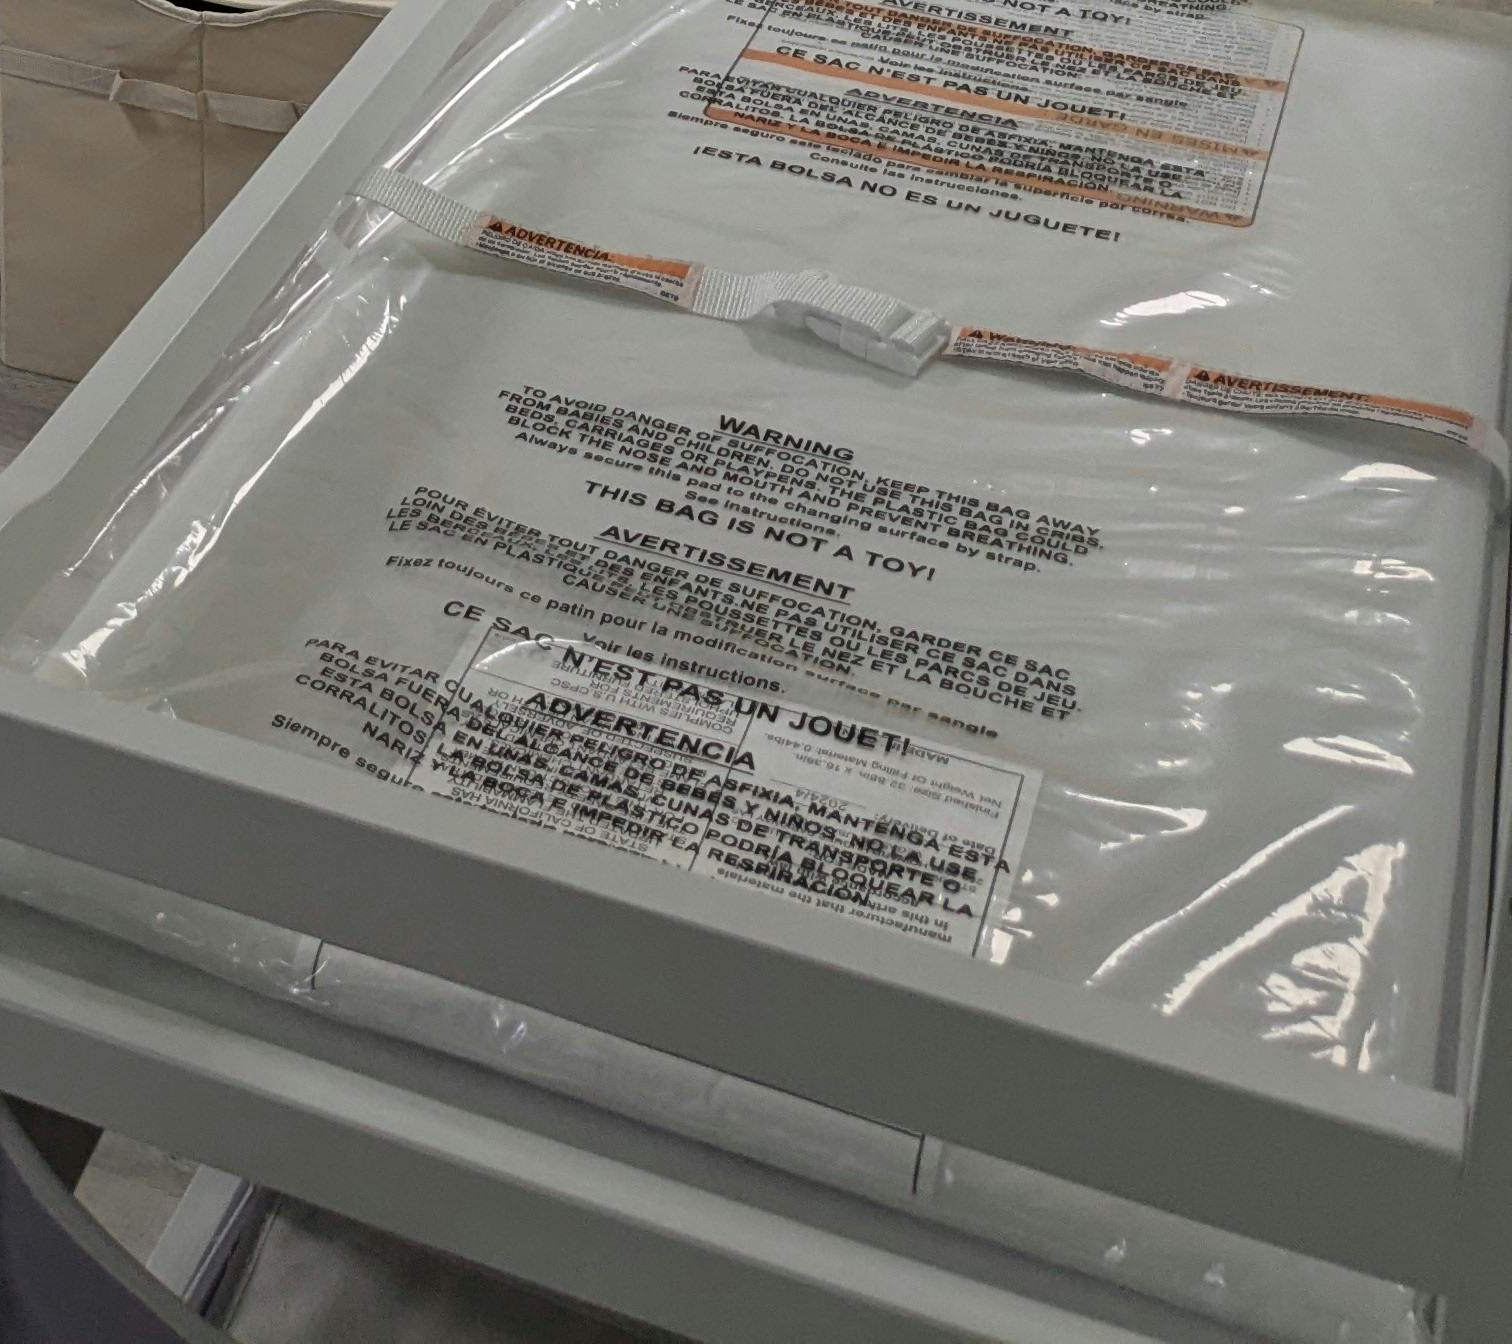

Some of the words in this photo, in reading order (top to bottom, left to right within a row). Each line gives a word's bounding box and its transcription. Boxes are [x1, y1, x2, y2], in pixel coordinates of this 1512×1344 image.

[1055, 6, 1072, 18] A
[1079, 9, 1133, 26] TOY!
[693, 145, 763, 167] ¡ESTA
[769, 160, 853, 188] BOLSA
[860, 179, 898, 197] NO
[905, 189, 938, 206] ES
[946, 199, 982, 213] UN
[988, 208, 1121, 242] JUGUETE!
[523, 385, 547, 399] TO
[550, 394, 607, 413] AVOID
[612, 407, 693, 436] DANGER
[696, 430, 722, 443] OF
[727, 439, 869, 482] SUFFOCATION,
[876, 475, 930, 495] KEEP
[937, 489, 979, 508] THIS
[986, 502, 1031, 520] BAG
[1036, 514, 1101, 537] AWAY
[719, 414, 855, 462] WARNING
[586, 479, 648, 507] THIS
[655, 498, 719, 526] BAG
[727, 516, 755, 535] IS
[763, 526, 829, 553] NOT
[833, 544, 854, 561] A
[865, 550, 937, 582] TOY!
[599, 525, 857, 602] AVERTISSEMENT
[443, 600, 486, 621] CE
[492, 616, 555, 652] SAC
[561, 645, 651, 688] N'EST
[661, 675, 724, 707] PAS
[733, 696, 780, 724] UN
[789, 711, 911, 757] JOUET!
[525, 693, 756, 771] ADVERTENCIA
